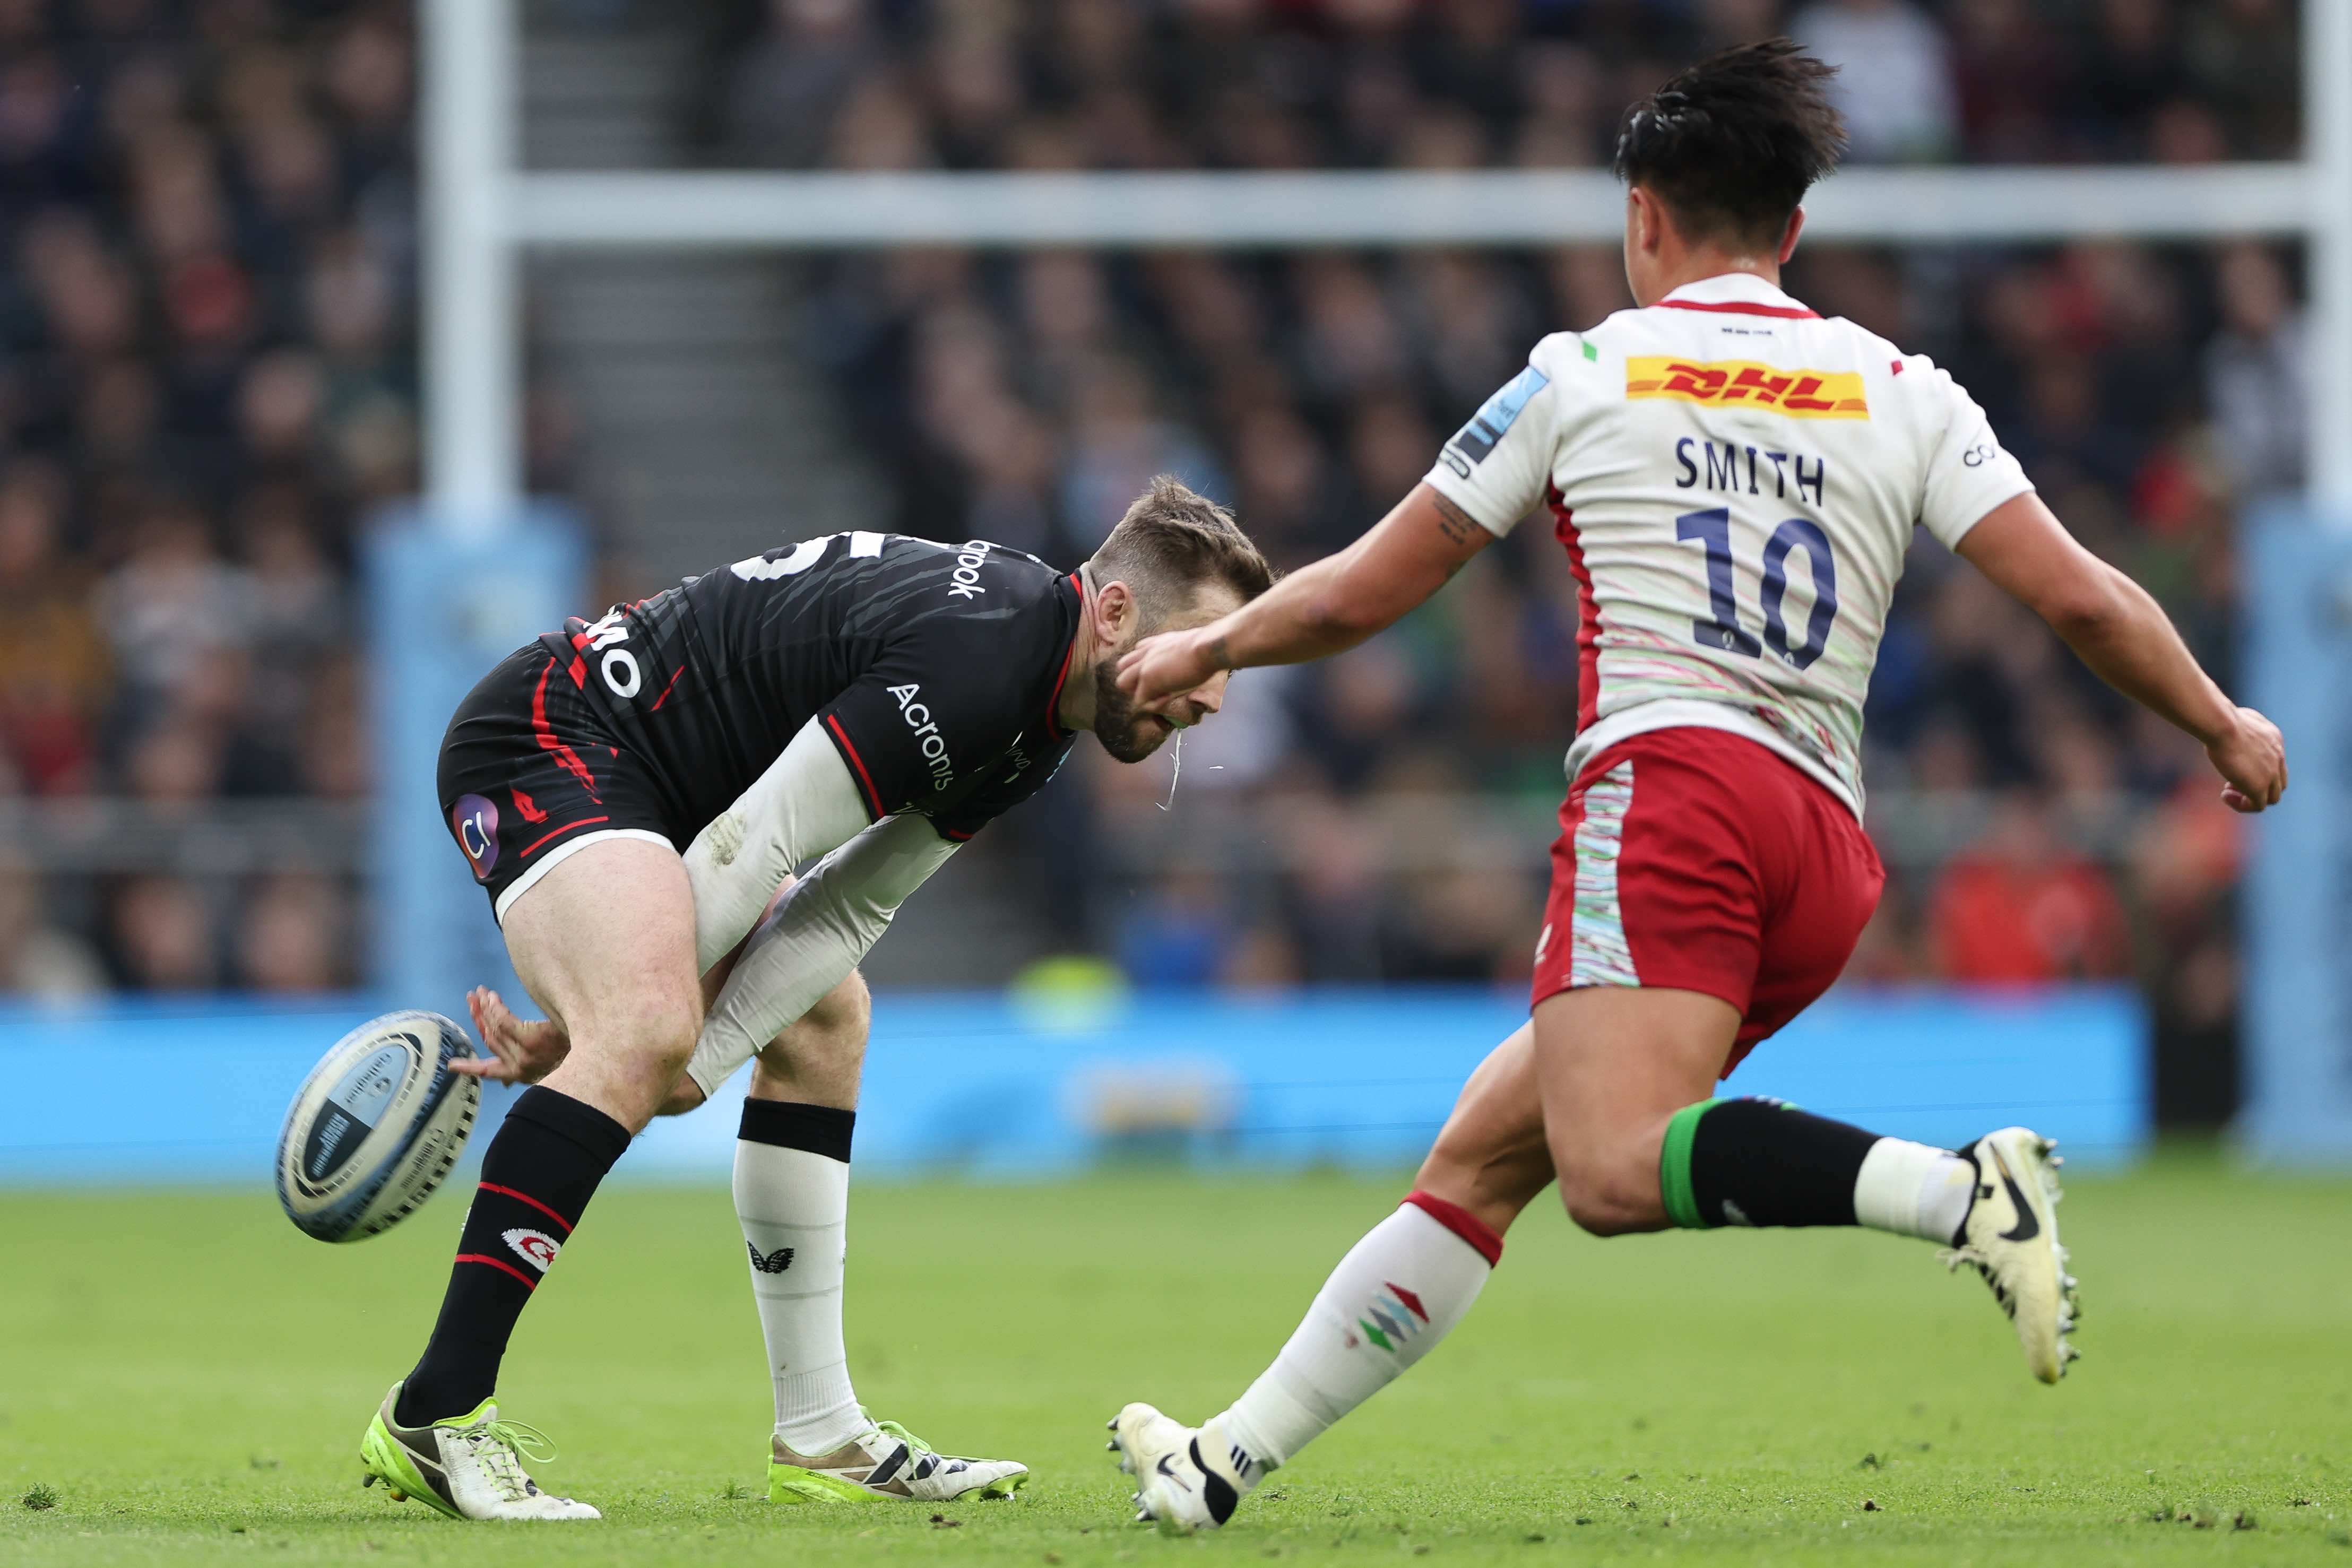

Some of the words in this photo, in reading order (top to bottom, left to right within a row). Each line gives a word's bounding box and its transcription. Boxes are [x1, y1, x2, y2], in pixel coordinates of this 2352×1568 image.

[1663, 363, 1835, 411] DHL
[1675, 437, 1823, 507] SMITH
[1676, 507, 1838, 670] 10
[886, 683, 954, 791] Acronis
